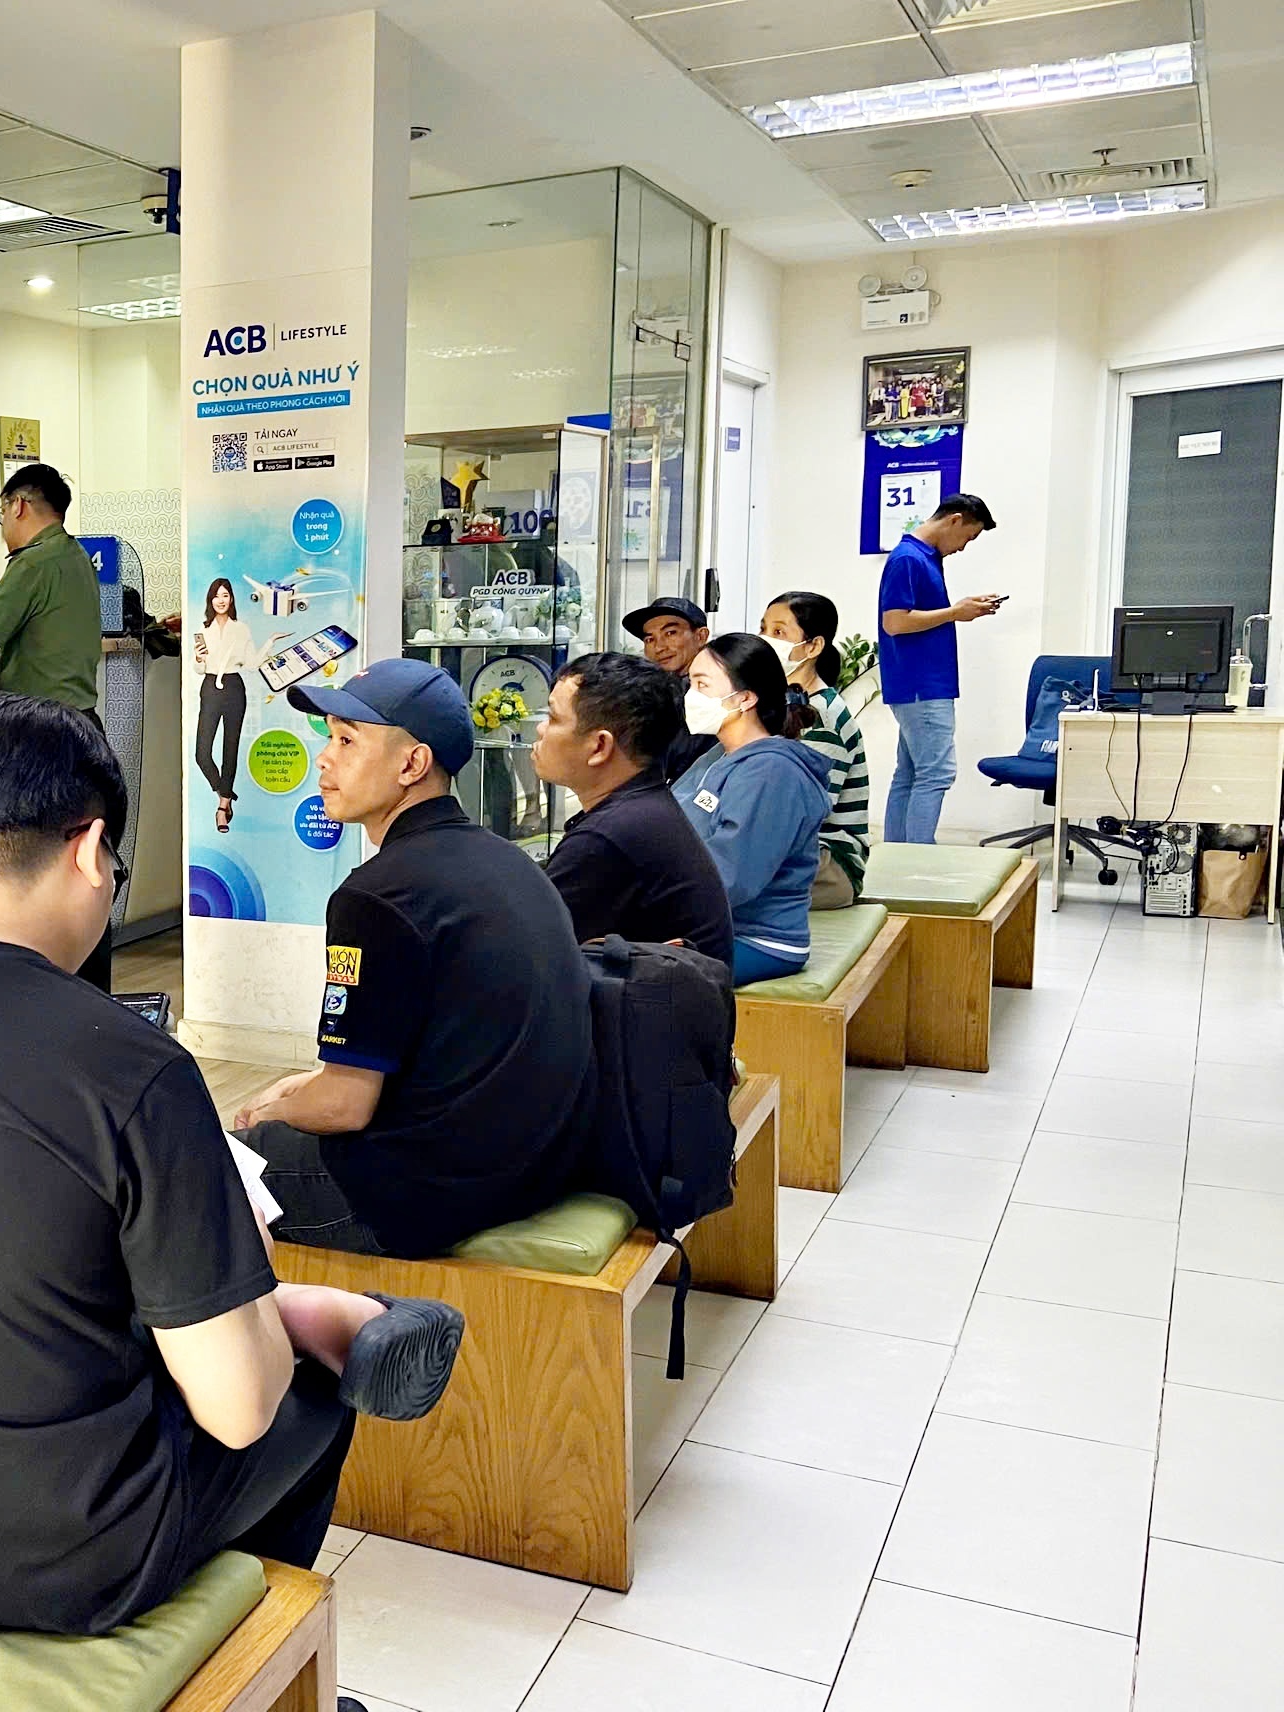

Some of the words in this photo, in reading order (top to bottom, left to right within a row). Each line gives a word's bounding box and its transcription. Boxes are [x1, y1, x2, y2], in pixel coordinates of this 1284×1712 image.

[281, 324, 347, 341] LIFESTYLE
[204, 325, 266, 357] ACB
[193, 375, 247, 396] CHỌN
[252, 368, 293, 391] QUÀ
[298, 365, 341, 386] NHƯ
[347, 360, 360, 381] Ý
[246, 402, 269, 411] THEO
[270, 399, 301, 409] PHONG
[302, 396, 327, 406] CÁCH
[329, 393, 346, 404] MỚI
[255, 428, 269, 439] TẢI
[272, 428, 298, 438] NGAY
[886, 486, 915, 507] 31
[300, 511, 319, 520] Nhận
[306, 523, 328, 531] trong
[311, 532, 329, 542] phút
[92, 551, 103, 571] 4
[494, 571, 528, 585] ACB
[500, 669, 515, 677] ACB
